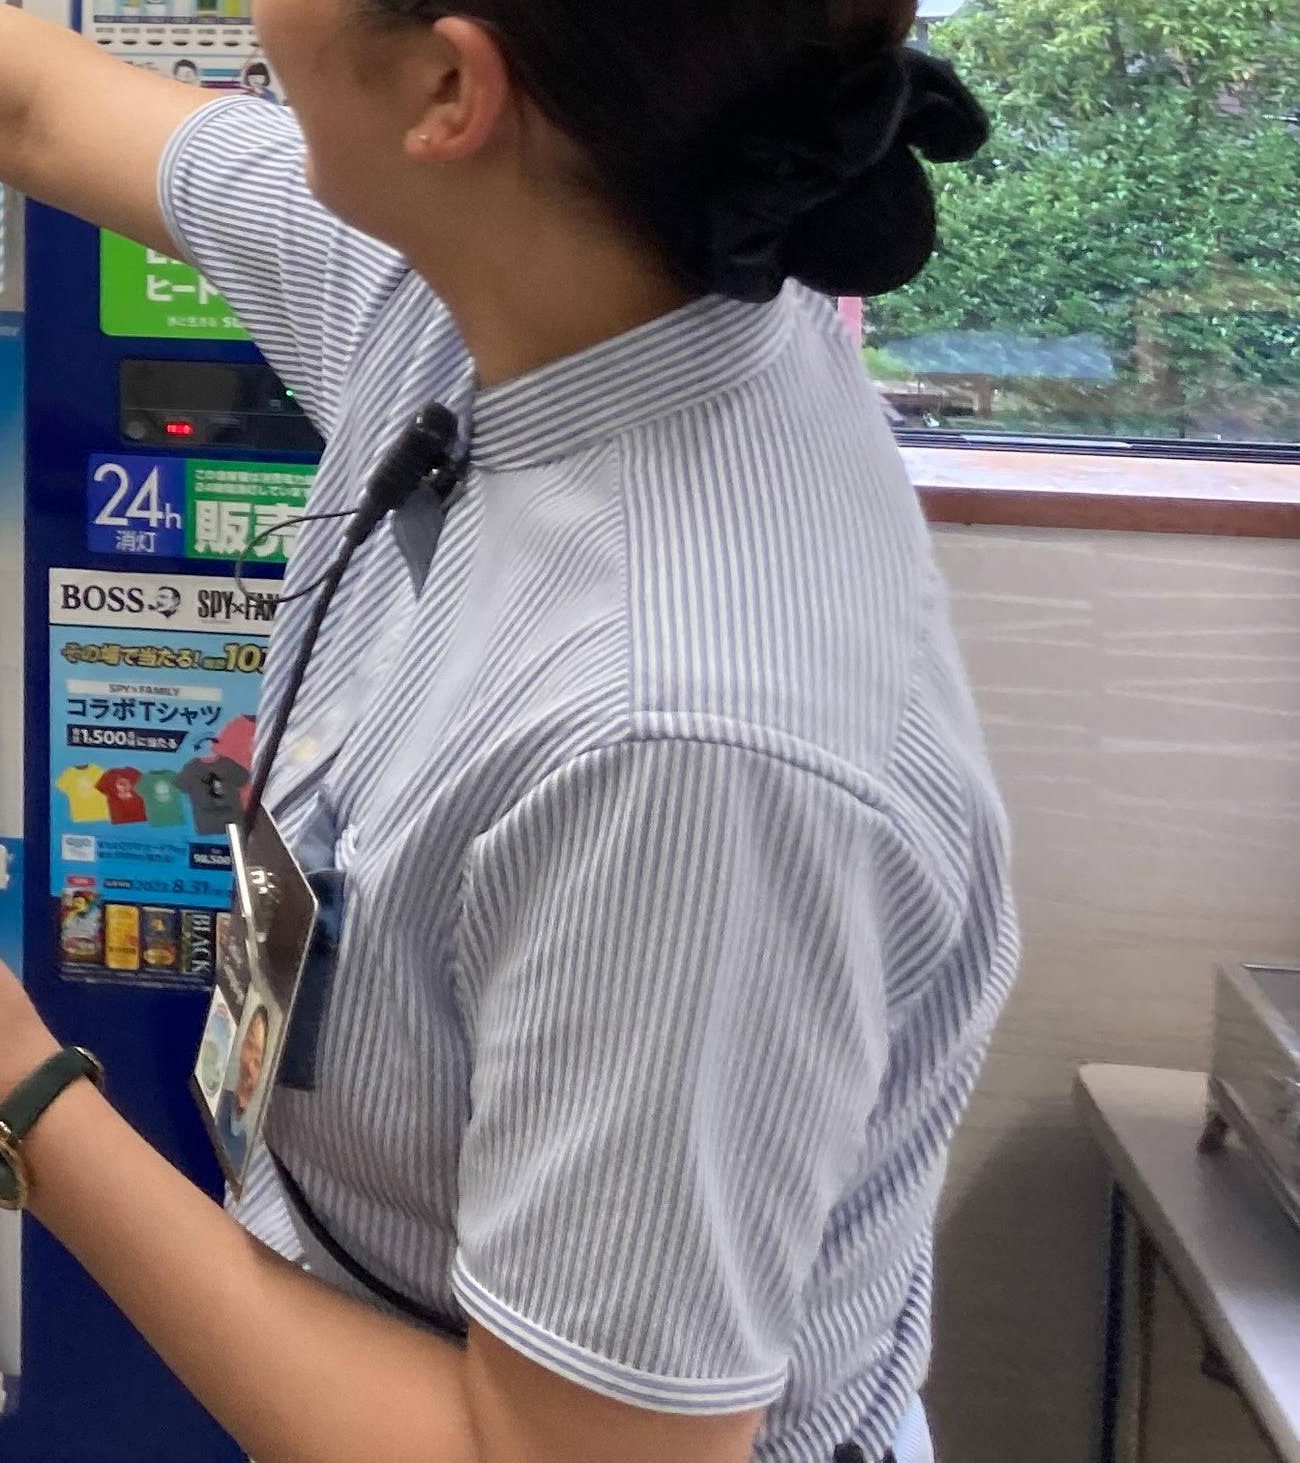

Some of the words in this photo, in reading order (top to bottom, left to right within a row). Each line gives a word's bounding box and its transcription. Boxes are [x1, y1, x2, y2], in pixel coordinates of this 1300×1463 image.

[93, 462, 183, 530] 24h
[115, 529, 157, 554] 消灯
[61, 584, 145, 614] BOSS
[61, 641, 202, 669] その場で当たる!
[67, 697, 222, 726] コラボTシャツ
